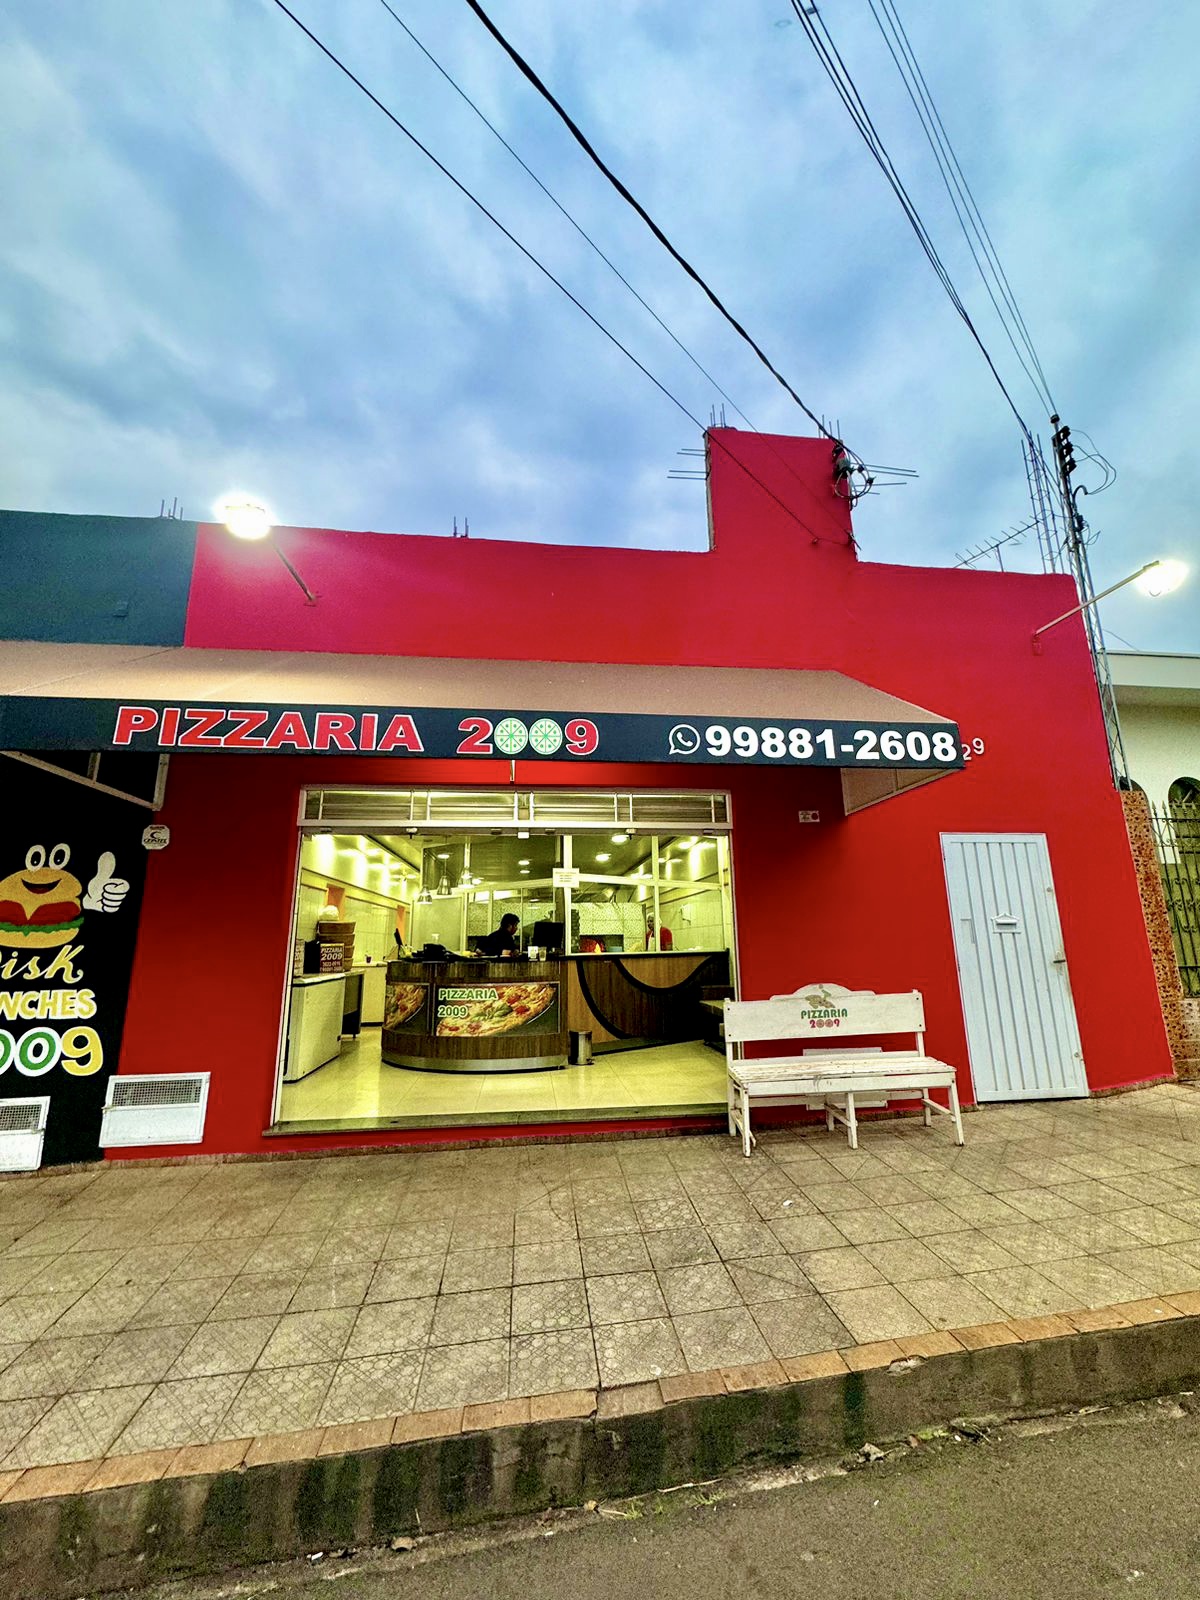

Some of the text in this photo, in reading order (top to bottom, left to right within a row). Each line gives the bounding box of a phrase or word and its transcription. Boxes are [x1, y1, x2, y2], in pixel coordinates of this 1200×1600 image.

[112, 706, 599, 756] PIZZARIA 2009
[705, 724, 958, 762] 99881-2608
[961, 737, 985, 761] 29
[321, 952, 343, 961] 2009
[438, 988, 499, 1001] PIZZARIA
[437, 1004, 469, 1018] 2009
[800, 1008, 848, 1019] PIZZARIA
[809, 1018, 840, 1028] 2009
